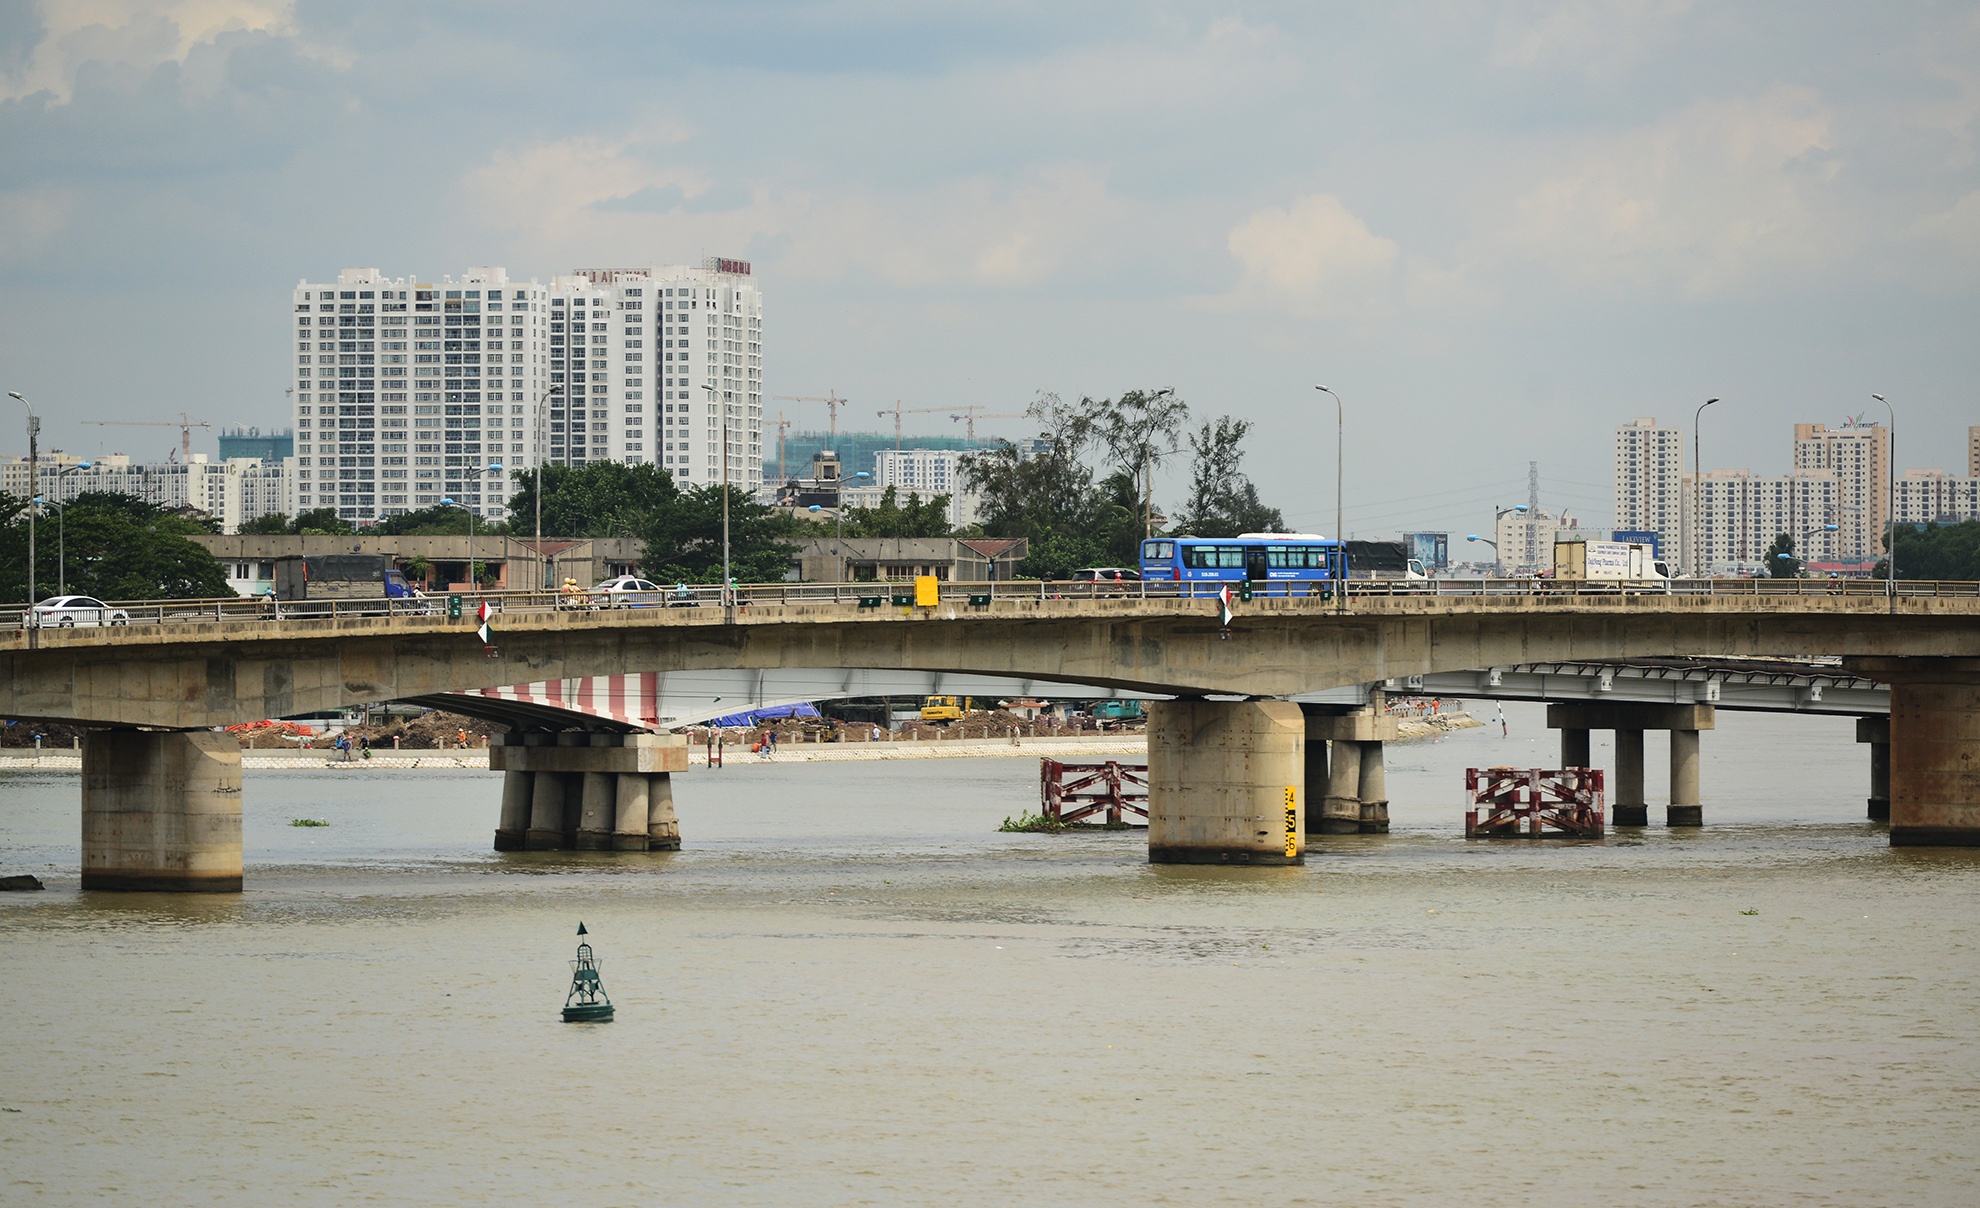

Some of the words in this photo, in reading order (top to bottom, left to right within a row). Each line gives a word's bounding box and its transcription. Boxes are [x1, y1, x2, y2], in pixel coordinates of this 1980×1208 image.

[1622, 535, 1651, 543] LAKEVIEW
[1289, 792, 1294, 803] 4
[1288, 815, 1296, 828] 5
[1288, 837, 1296, 850] 6
